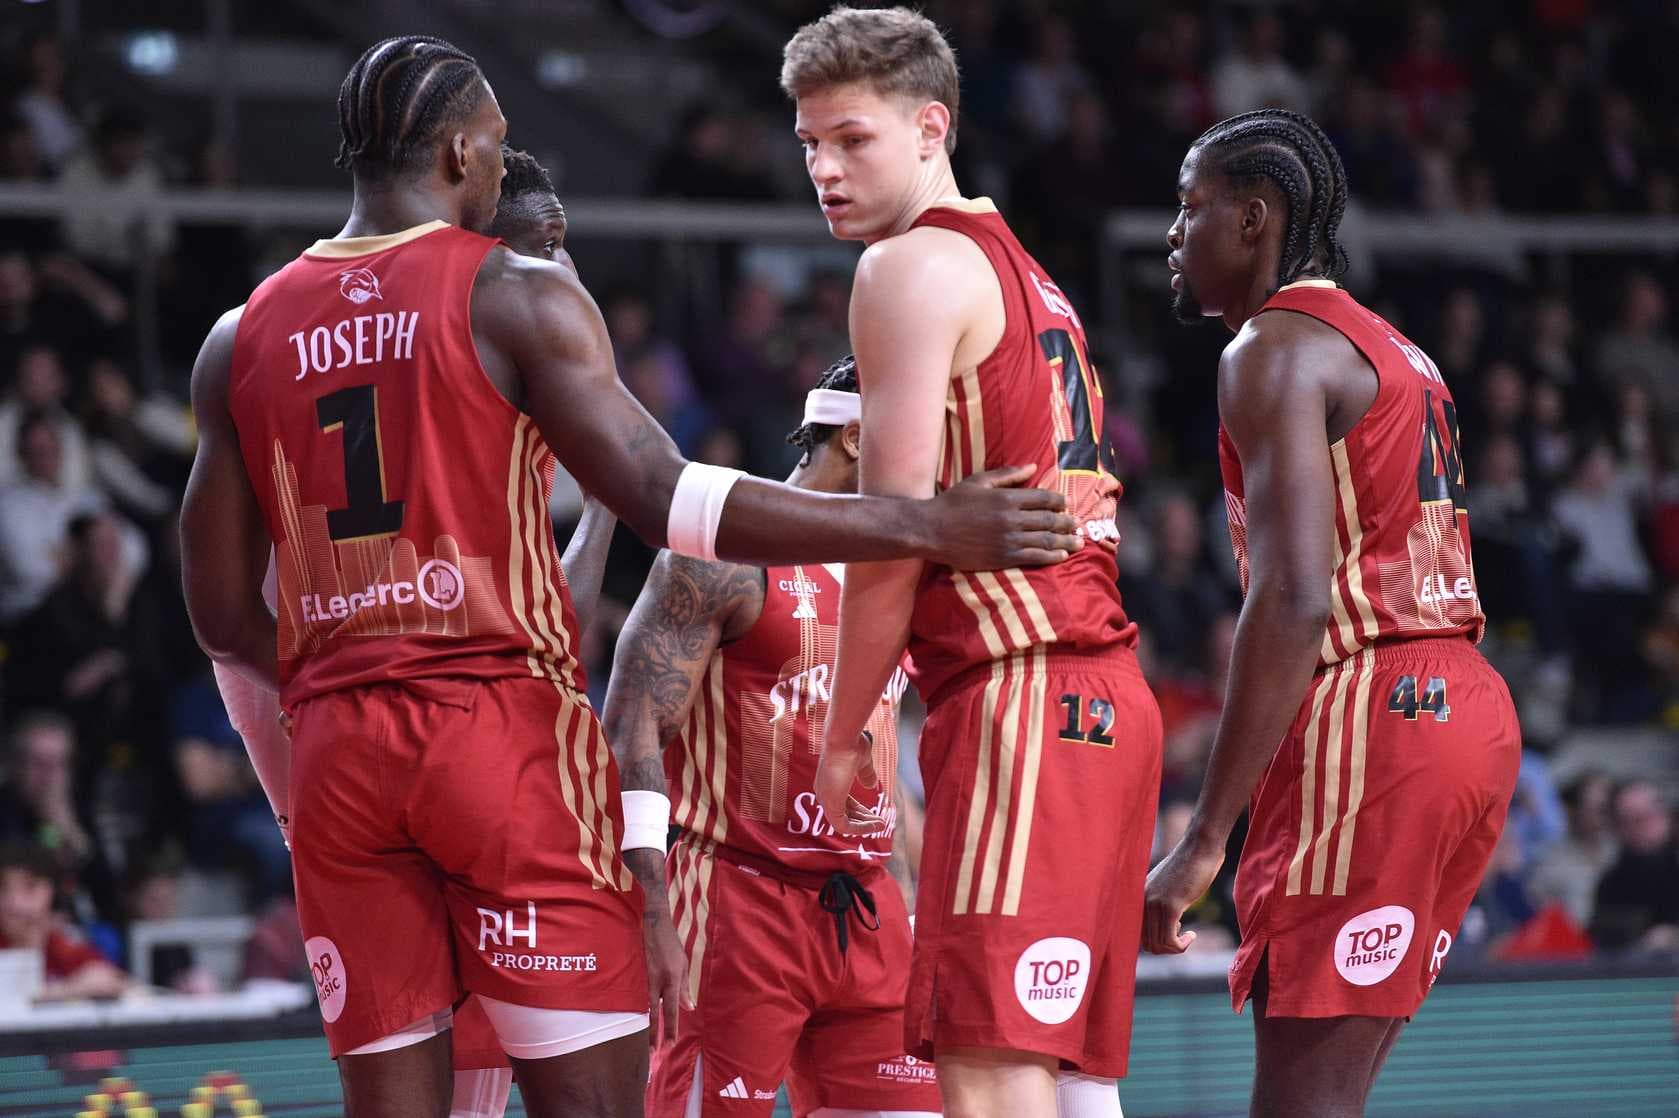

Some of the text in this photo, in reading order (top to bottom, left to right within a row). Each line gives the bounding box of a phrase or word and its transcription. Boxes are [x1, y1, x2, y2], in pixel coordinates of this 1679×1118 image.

[289, 311, 419, 381] JOSEPH
[316, 384, 406, 545] 1
[1388, 674, 1451, 722] 44
[1059, 694, 1116, 749] 12
[476, 899, 537, 951] RH
[1349, 923, 1402, 955] TOP
[312, 953, 333, 988] OP
[491, 952, 597, 971] PROPRETÉ
[1030, 959, 1080, 987] TOP
[1346, 948, 1397, 967] music
[319, 977, 341, 1001] usic
[1028, 986, 1077, 1001] music
[877, 1063, 937, 1080] PRESTIGE
